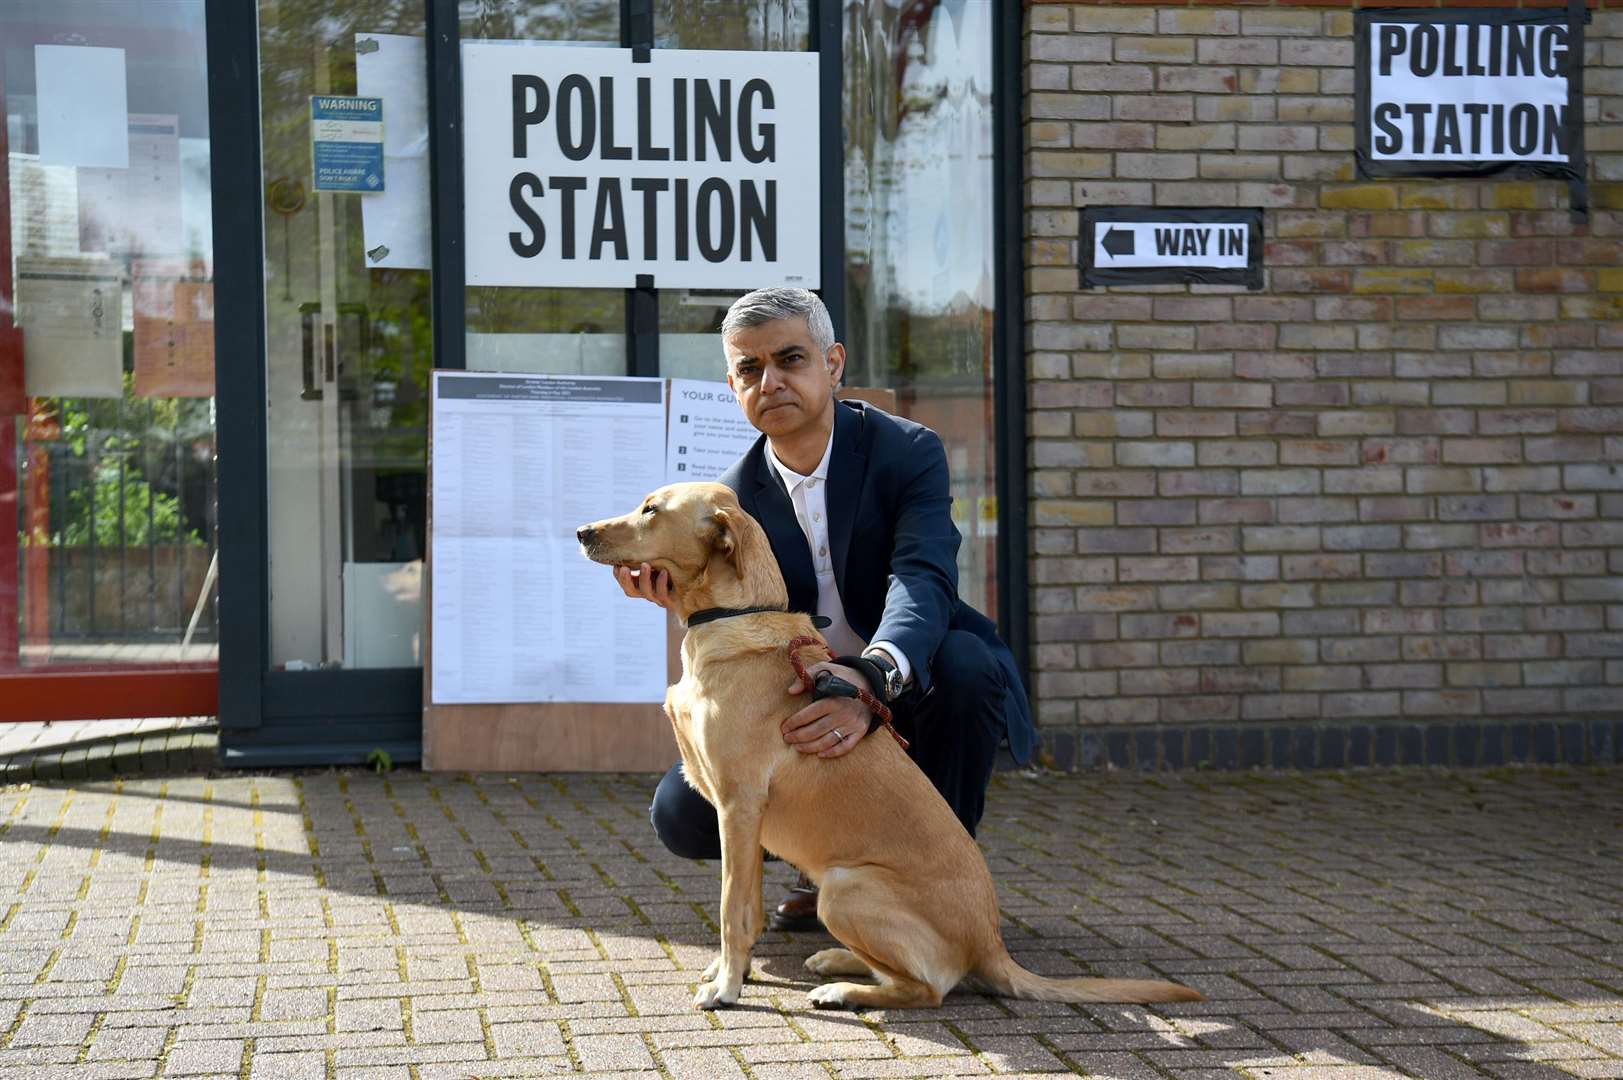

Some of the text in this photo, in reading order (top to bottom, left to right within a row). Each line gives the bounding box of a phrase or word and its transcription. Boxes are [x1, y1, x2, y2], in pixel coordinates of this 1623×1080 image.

[1379, 23, 1569, 78] POLLING
[319, 99, 377, 111] WARNING
[512, 73, 776, 164] POLLING
[1374, 102, 1569, 155] STATION
[508, 171, 777, 263] STATION
[1154, 228, 1244, 256] WAY IN
[682, 390, 714, 401] YOUR
